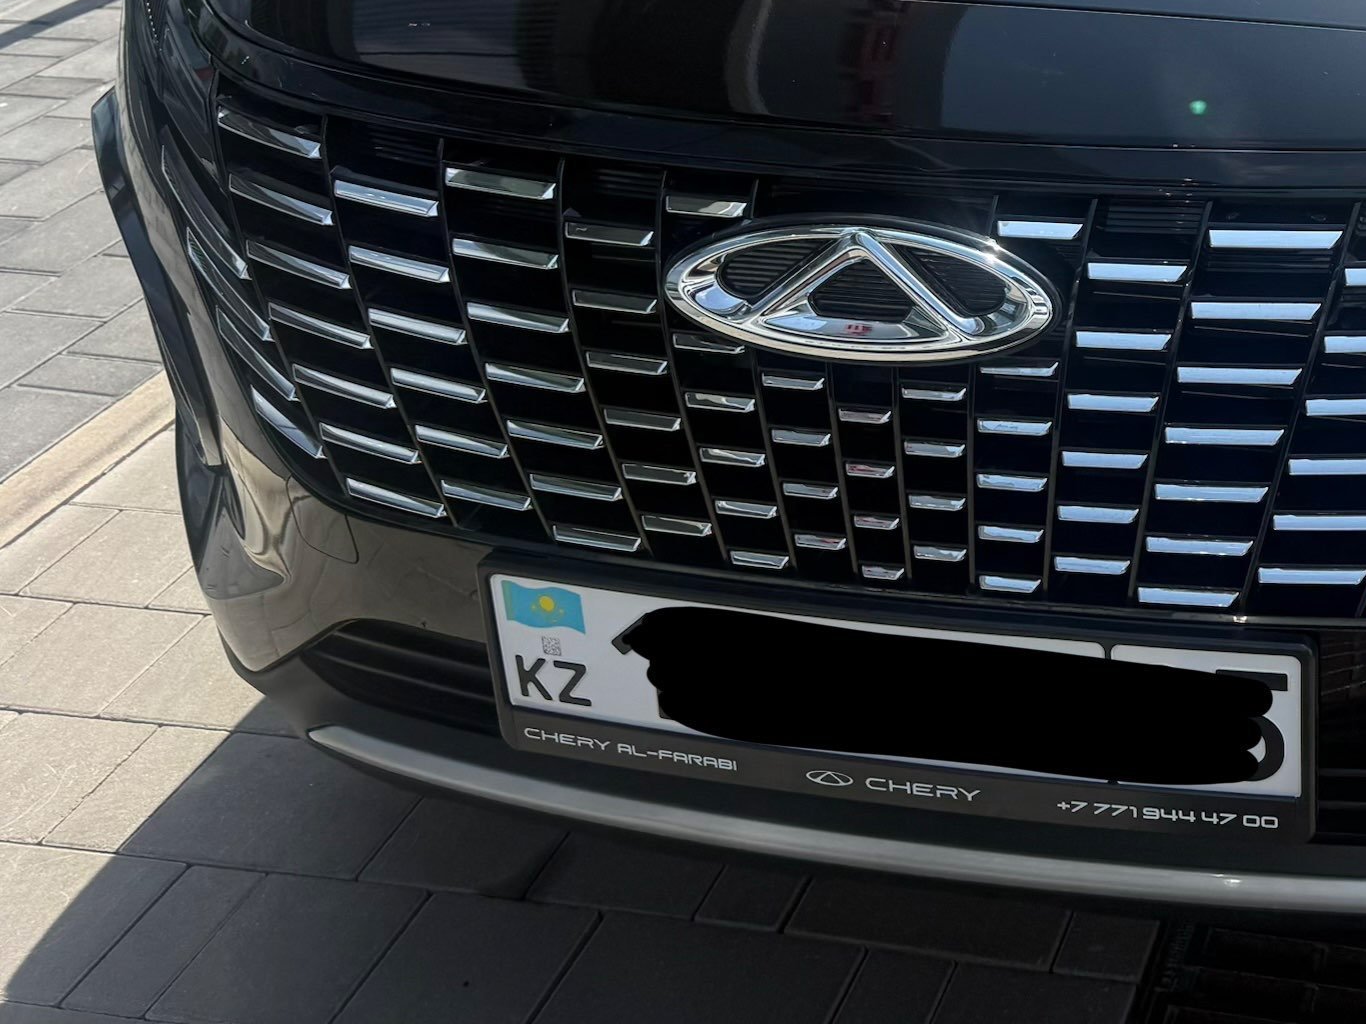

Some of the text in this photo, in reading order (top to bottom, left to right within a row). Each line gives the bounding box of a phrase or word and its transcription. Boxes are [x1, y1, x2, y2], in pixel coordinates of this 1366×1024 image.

[515, 654, 592, 707] KZ
[524, 727, 738, 771] CHERY AL-FARABI
[865, 777, 981, 802] CHERY
[1057, 800, 1279, 829] +7 771 944 47 00
